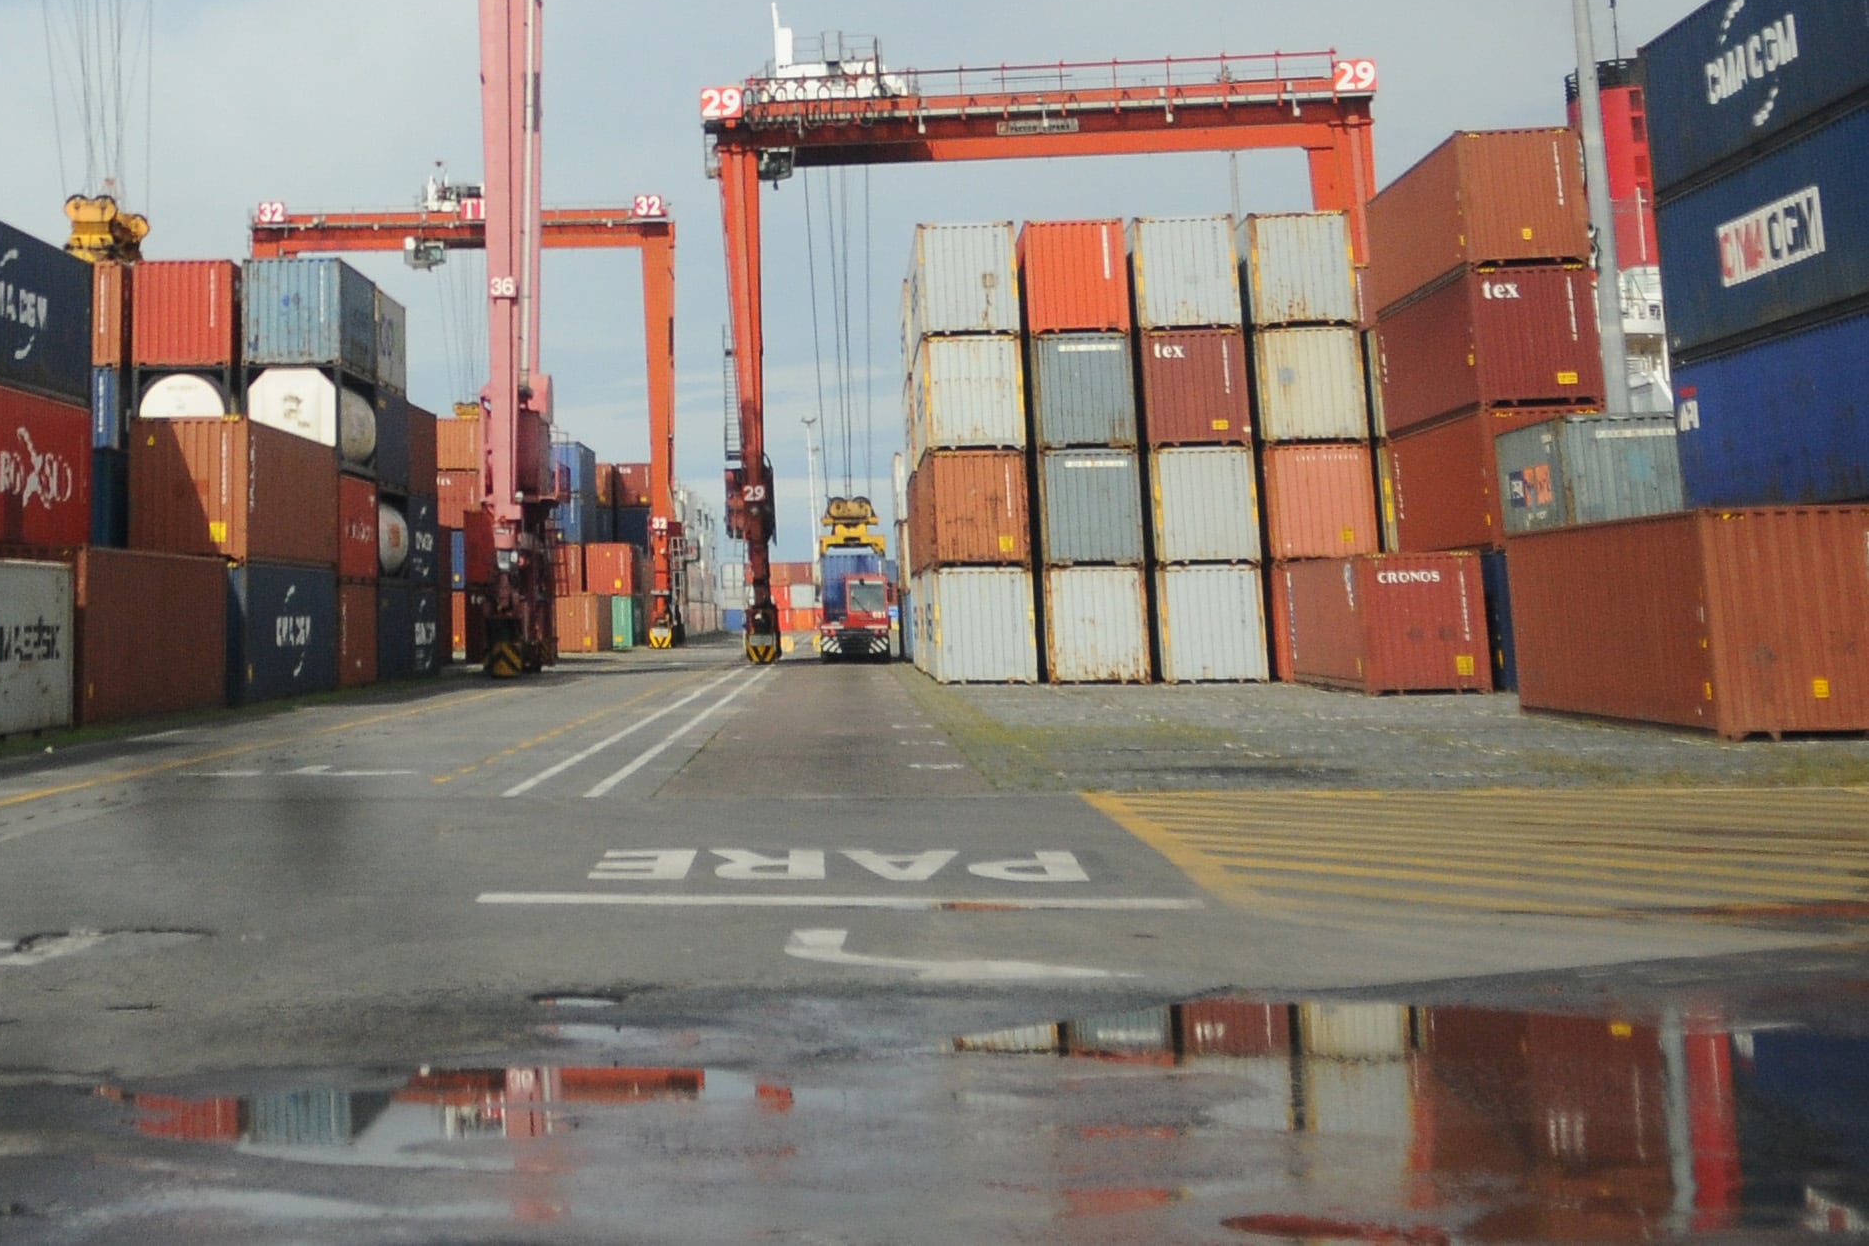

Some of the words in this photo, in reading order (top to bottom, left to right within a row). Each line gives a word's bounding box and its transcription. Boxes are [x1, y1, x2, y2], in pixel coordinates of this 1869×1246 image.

[1336, 60, 1376, 91] 29
[702, 89, 740, 118] 29
[258, 202, 285, 222] 32
[633, 195, 662, 217] 32
[490, 276, 514, 296] 36
[1482, 280, 1520, 299] tex
[1153, 342, 1186, 358] tex
[742, 485, 765, 501] 29
[652, 516, 667, 530] 32
[1376, 570, 1442, 584] CRONOS
[586, 847, 1091, 884] PARE
